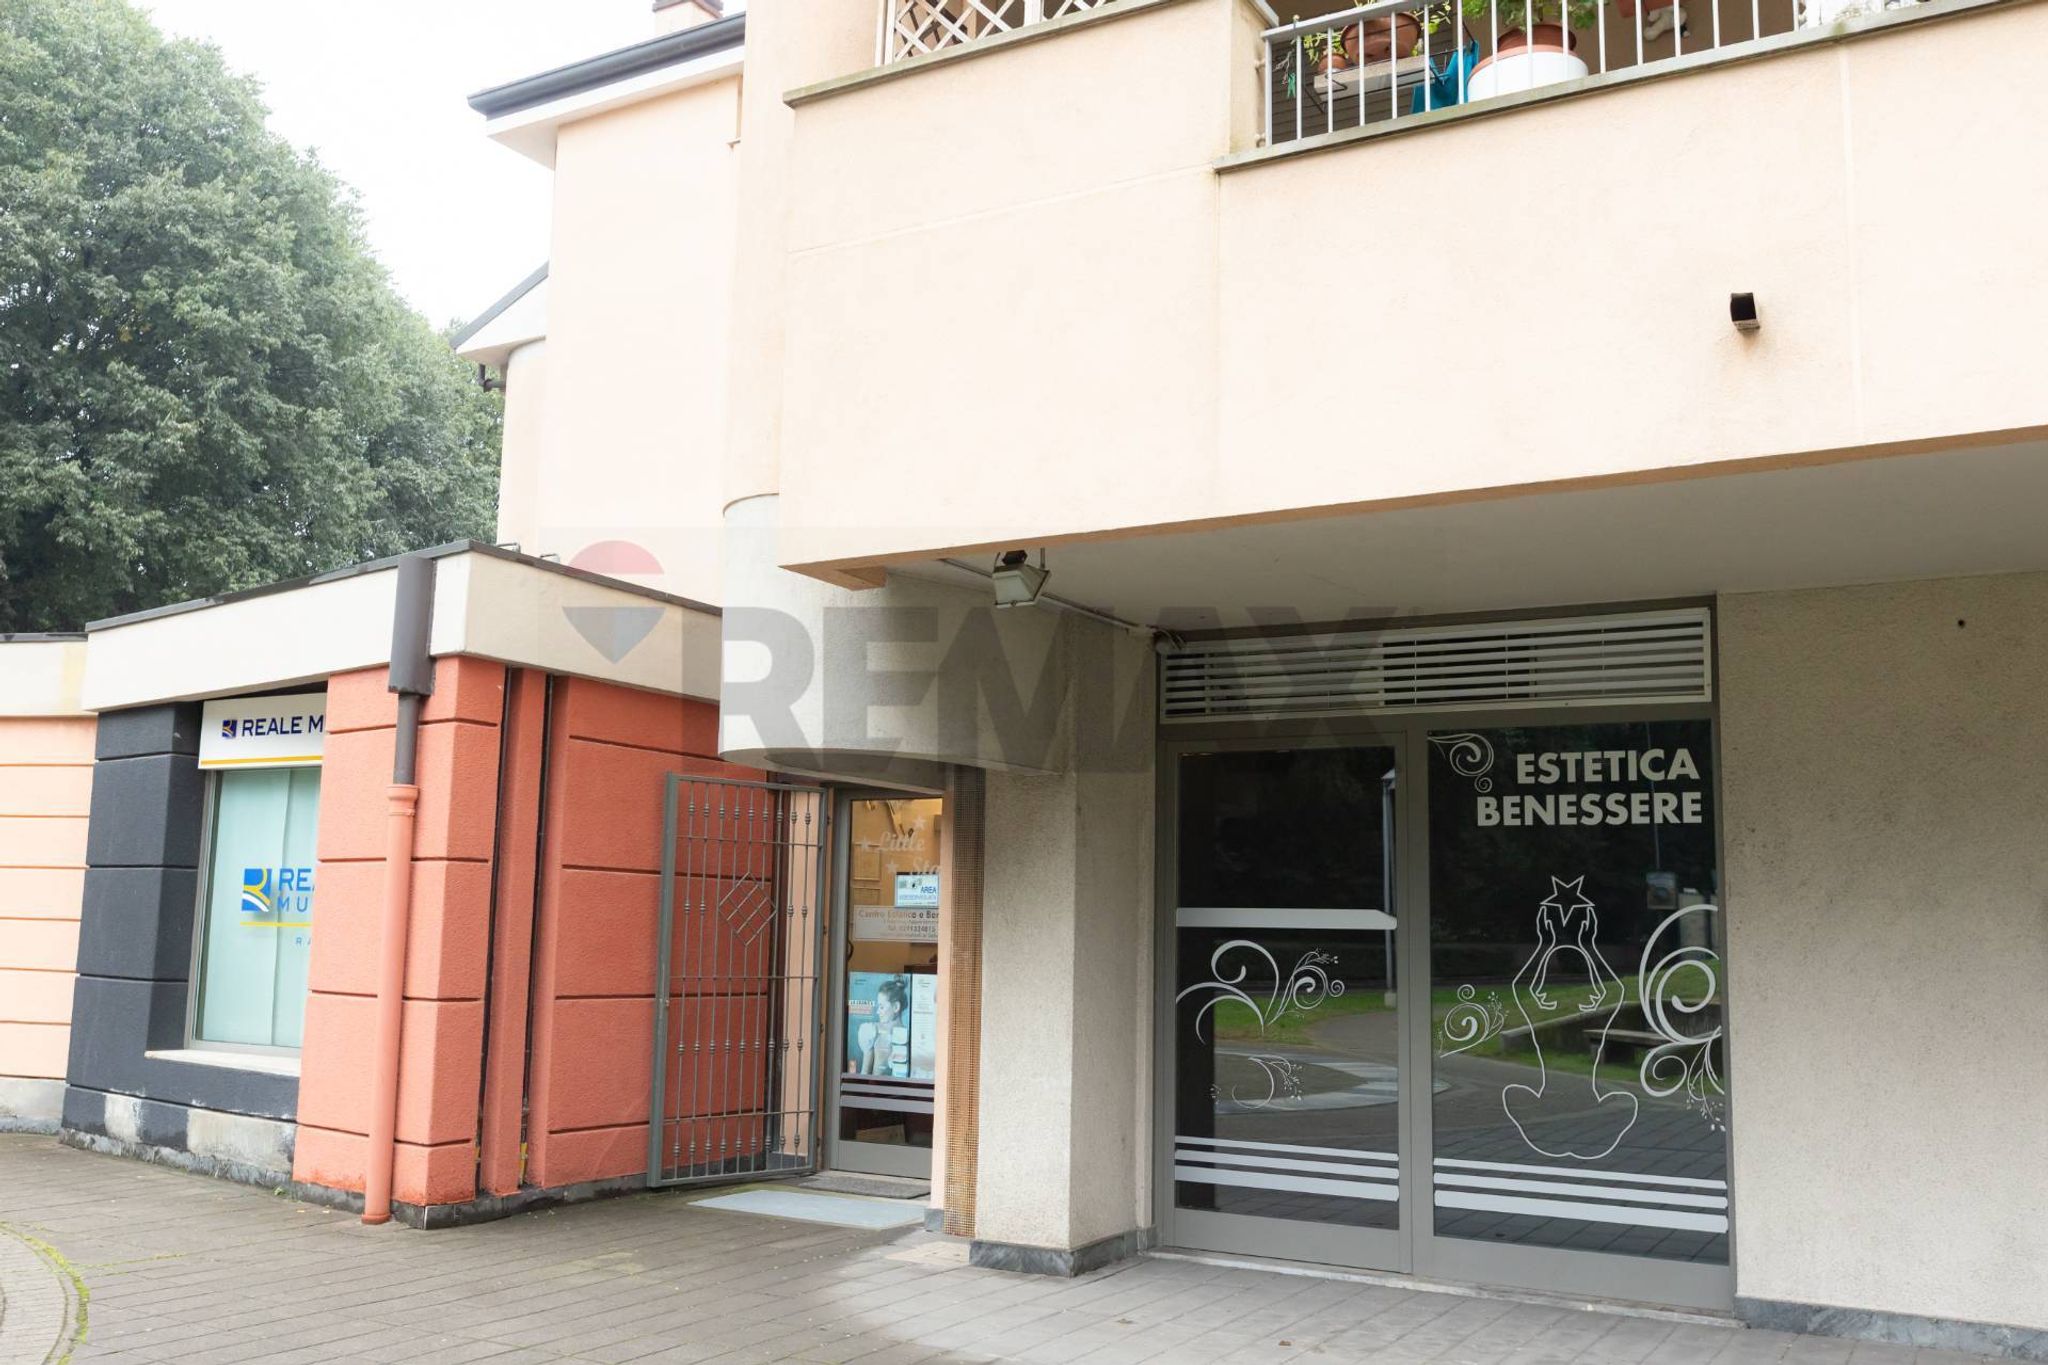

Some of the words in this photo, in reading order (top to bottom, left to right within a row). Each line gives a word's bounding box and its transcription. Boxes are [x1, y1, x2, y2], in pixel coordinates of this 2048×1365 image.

[242, 716, 303, 737] REALE
[1516, 748, 1700, 785] ESTETICA
[1477, 792, 1703, 827] BENESSERE
[876, 831, 925, 852] Little
[278, 868, 315, 892] RE
